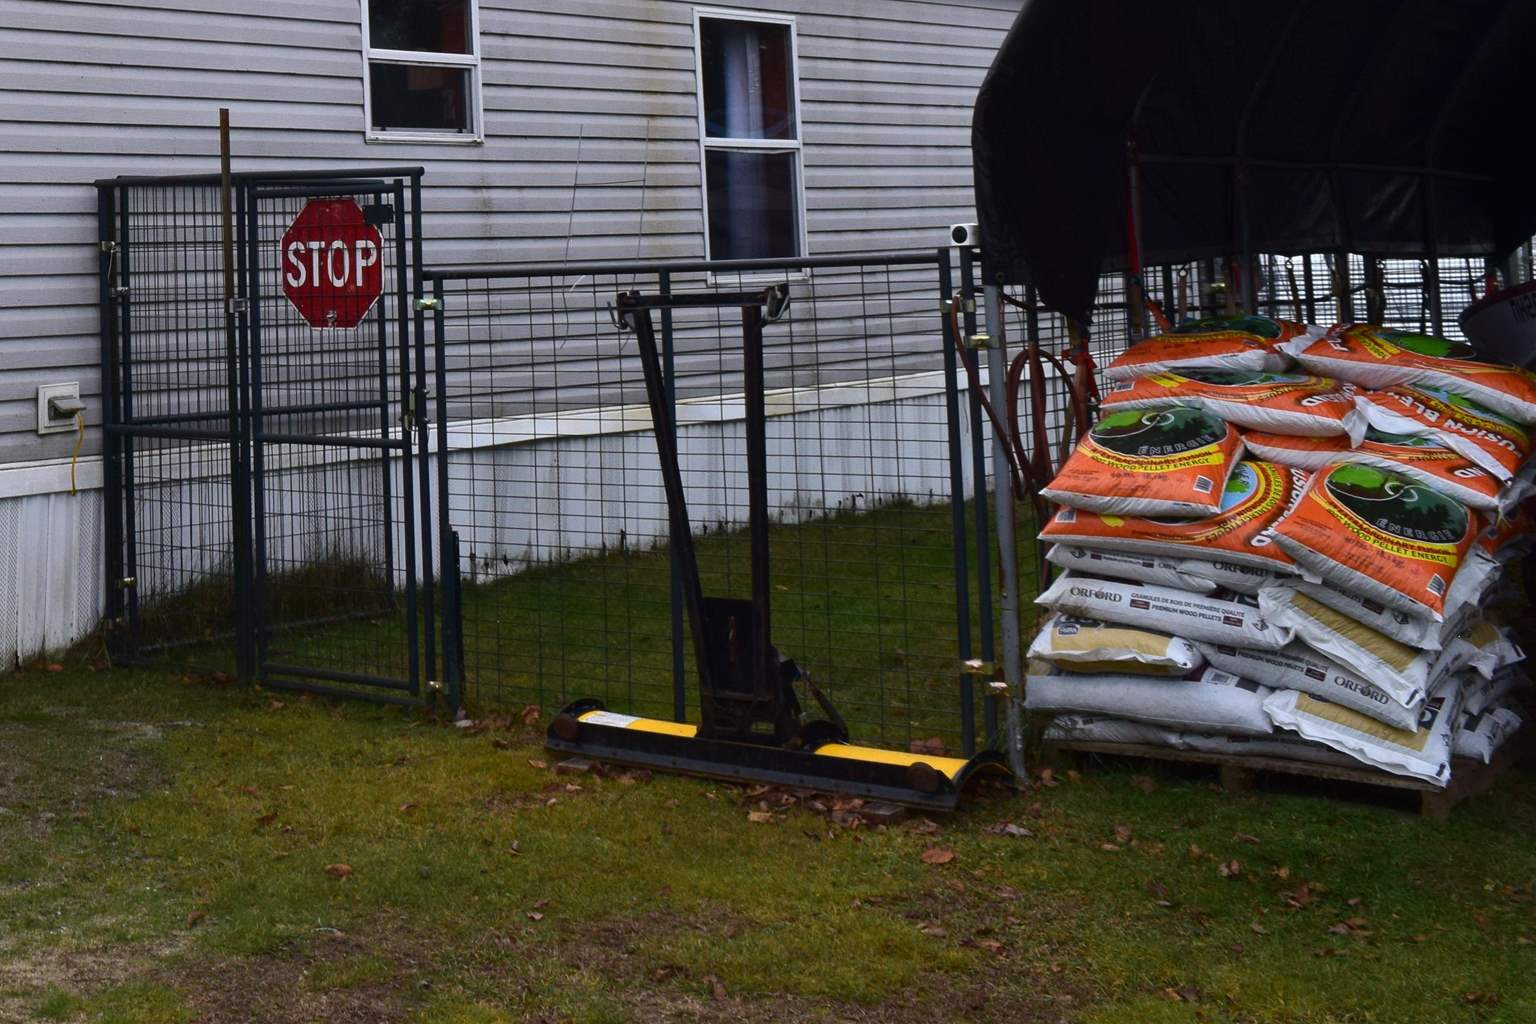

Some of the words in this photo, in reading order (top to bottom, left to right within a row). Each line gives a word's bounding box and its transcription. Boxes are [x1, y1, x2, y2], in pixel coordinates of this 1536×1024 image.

[286, 239, 378, 288] STOP
[1109, 459, 1136, 472] WOOD
[1138, 462, 1171, 472] PELLET
[1173, 457, 1210, 468] ENERGY
[1344, 520, 1372, 542] WOOD
[1372, 539, 1412, 558] PELLET
[1413, 549, 1450, 564] ENERGY
[1069, 586, 1123, 603] ORFORD
[1130, 592, 1160, 603] GRANULES
[1169, 598, 1181, 606] BOIS
[1152, 604, 1179, 614] PREMIUM
[1179, 608, 1198, 618] WOOD
[1198, 611, 1222, 622] PELLETS
[1265, 657, 1284, 667] WOOD
[1334, 675, 1390, 706] ORFORD
